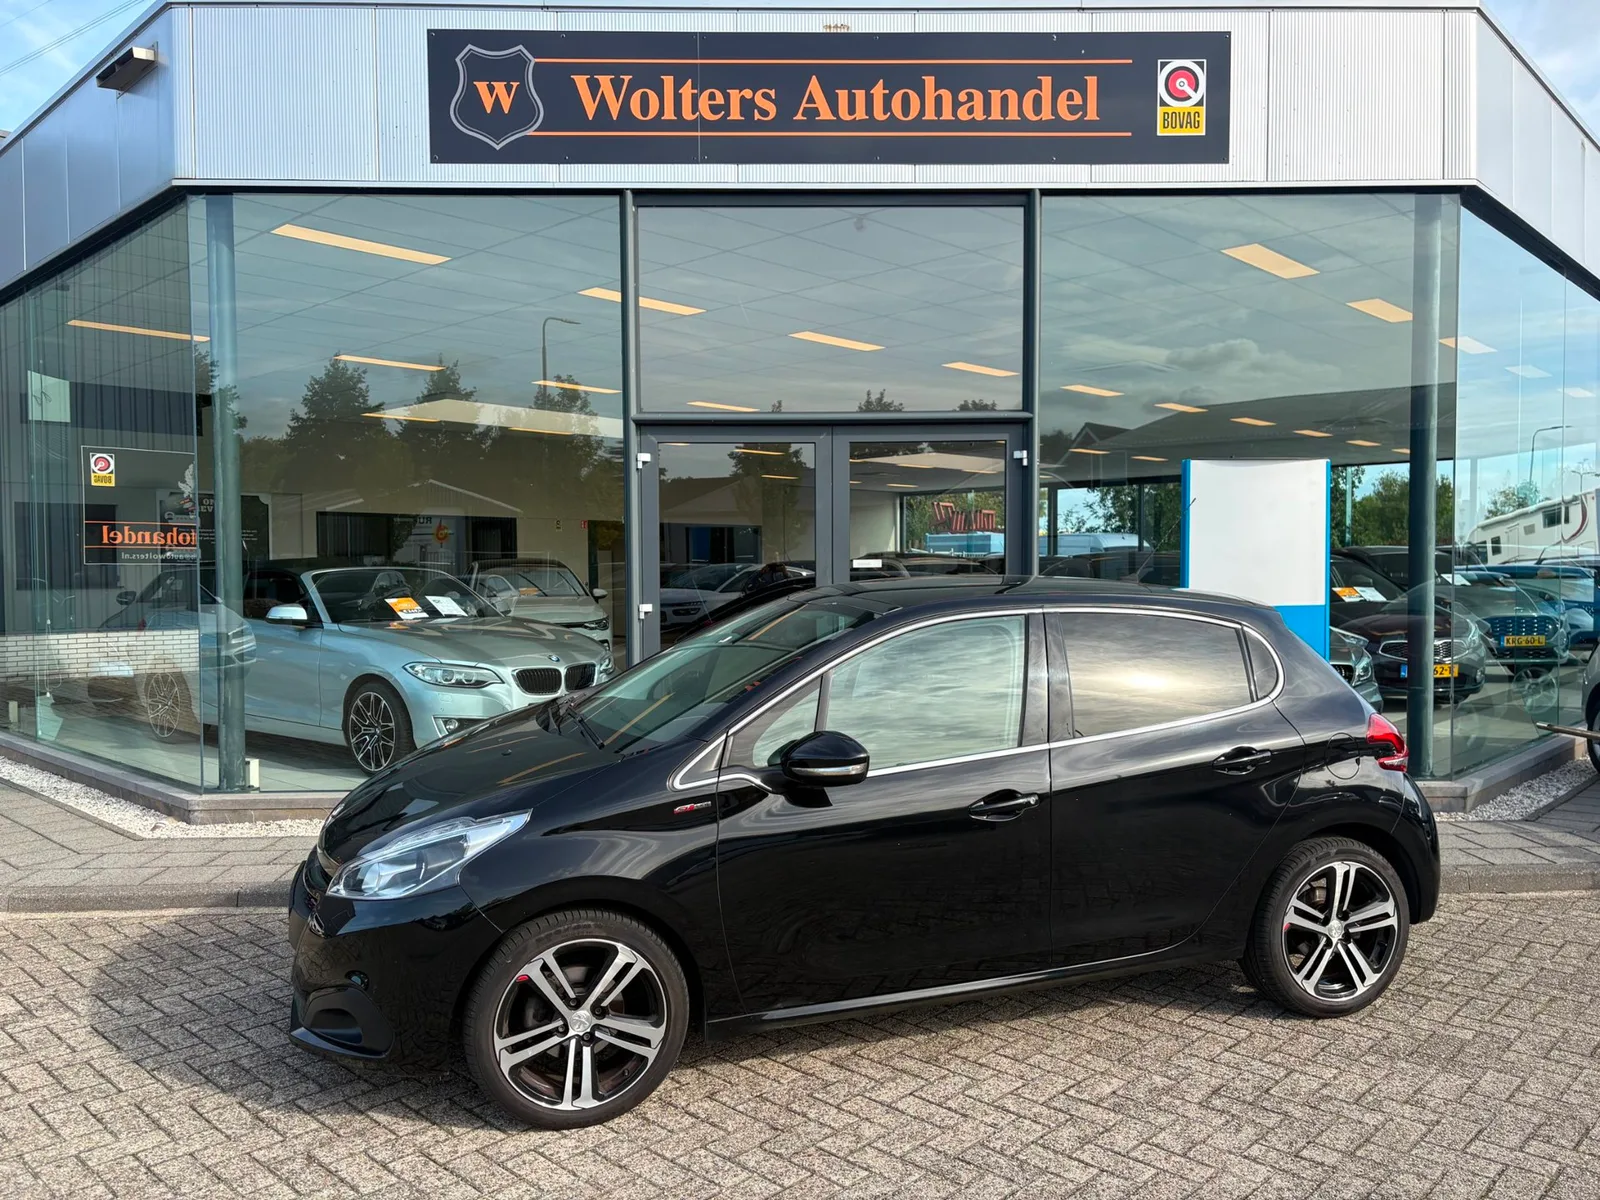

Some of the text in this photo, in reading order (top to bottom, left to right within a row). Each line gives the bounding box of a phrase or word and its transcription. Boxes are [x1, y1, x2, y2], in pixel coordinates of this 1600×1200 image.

[473, 81, 520, 114] W
[571, 74, 1100, 122] Wolters Autohandel
[1162, 110, 1201, 130] BOVAG
